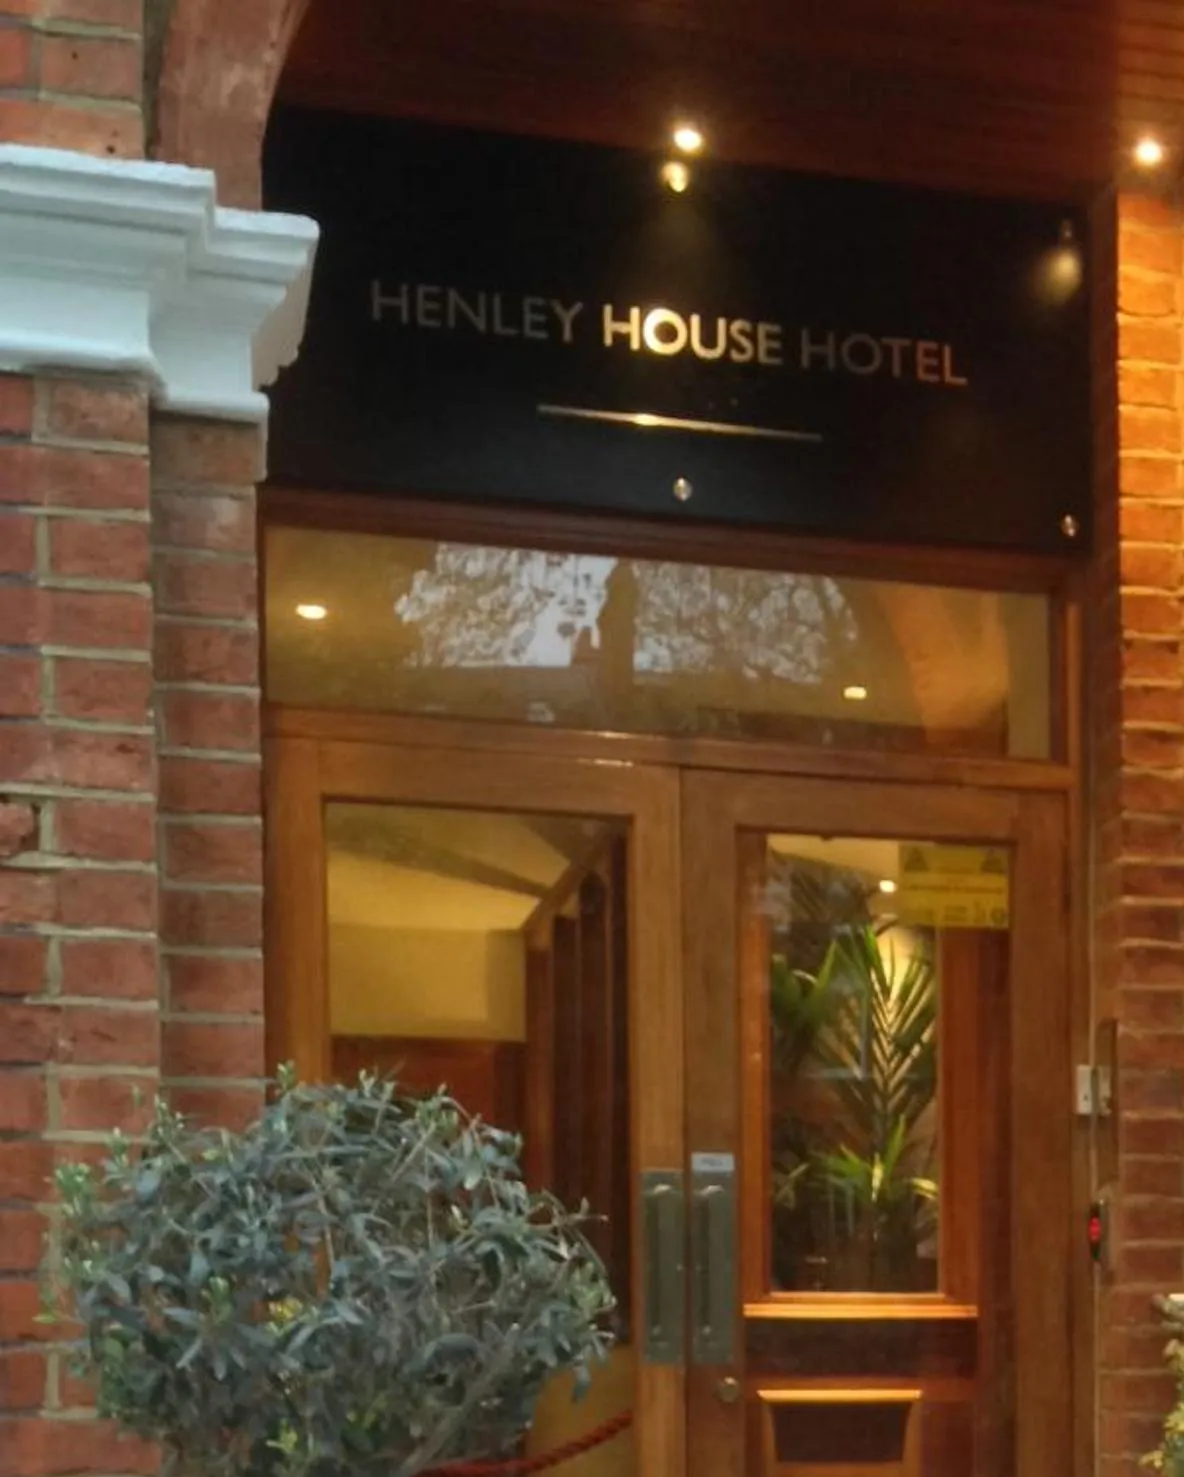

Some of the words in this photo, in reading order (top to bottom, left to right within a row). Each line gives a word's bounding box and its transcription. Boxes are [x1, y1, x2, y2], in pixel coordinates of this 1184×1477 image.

[371, 280, 583, 343] HENLEY
[603, 303, 782, 366] HOUSE
[800, 328, 968, 387] HOTEL
